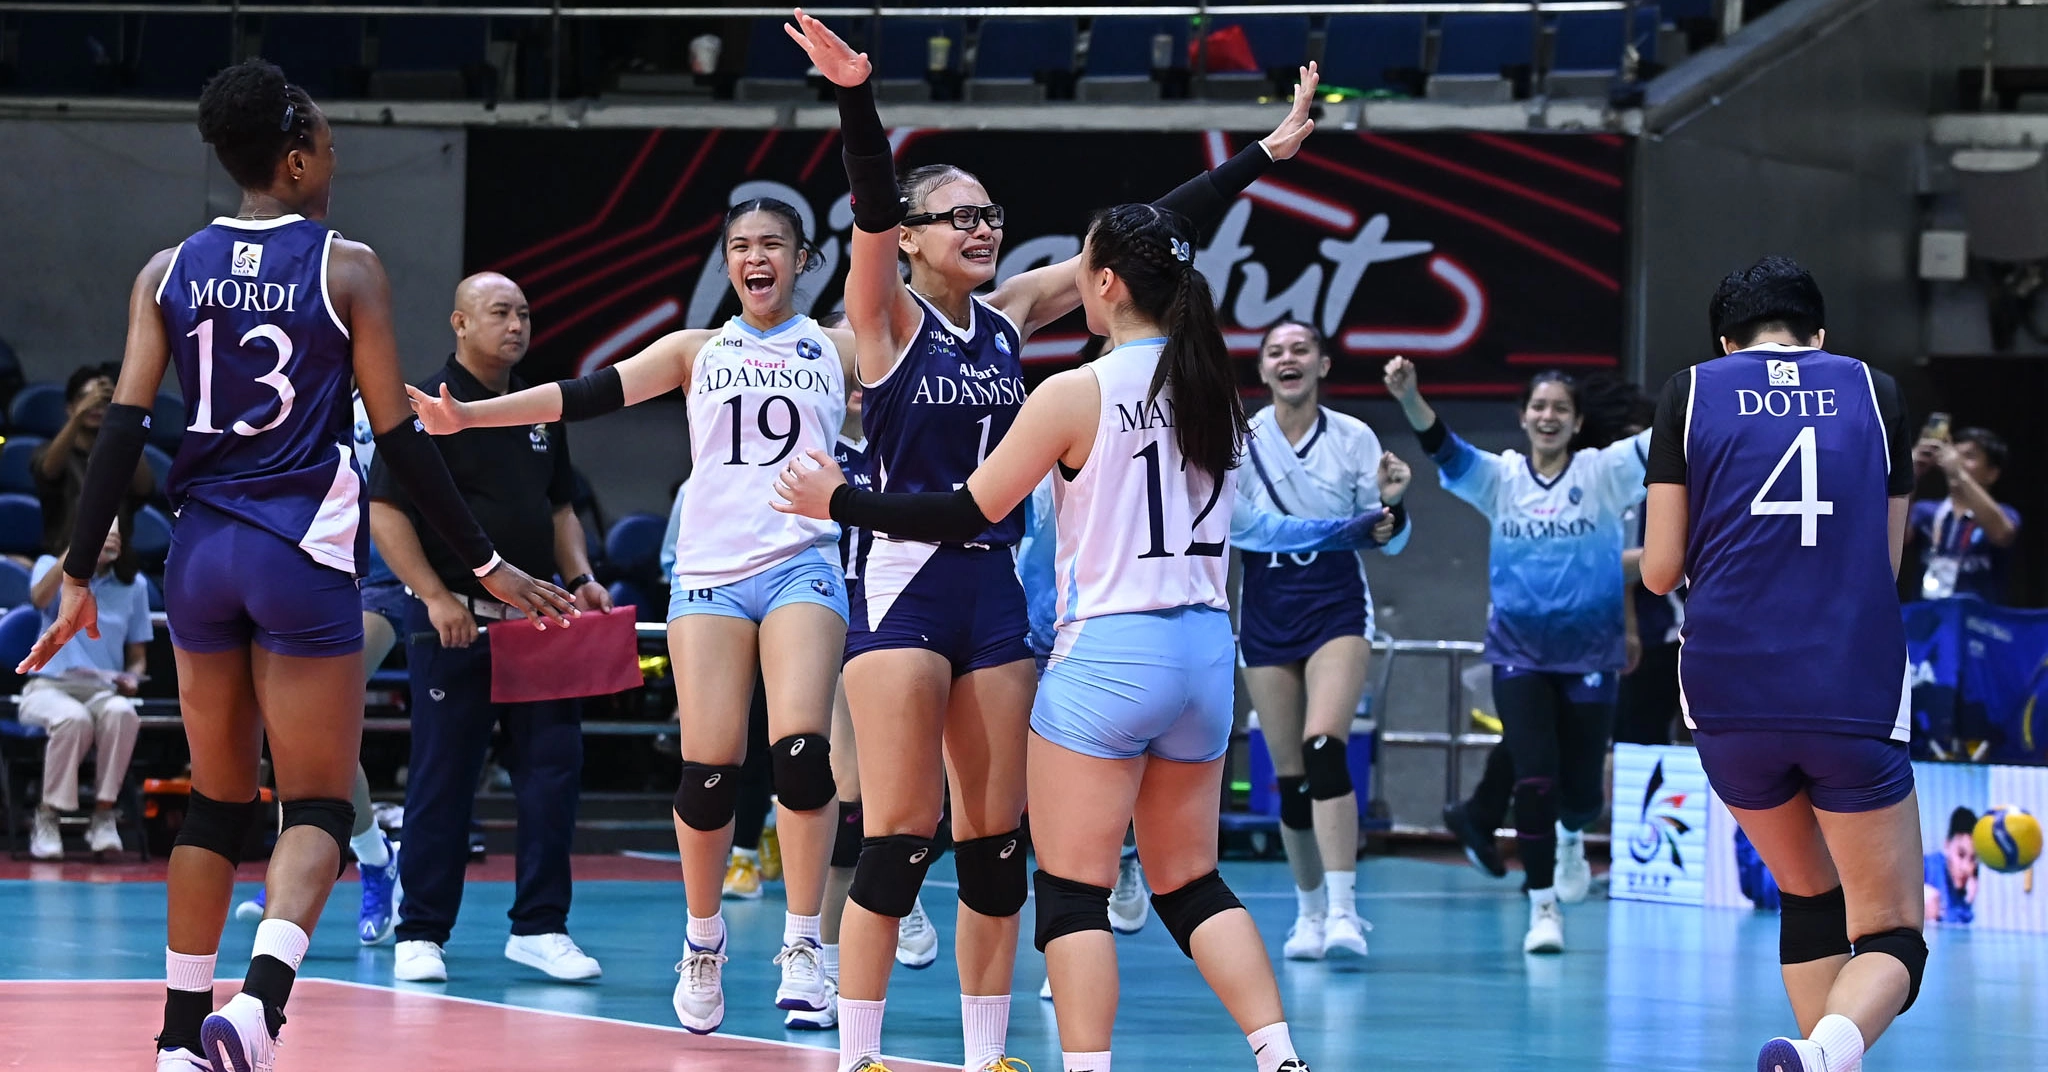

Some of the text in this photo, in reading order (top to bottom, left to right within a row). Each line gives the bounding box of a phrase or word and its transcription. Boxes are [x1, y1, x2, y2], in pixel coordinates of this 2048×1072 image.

[188, 278, 299, 312] MORDI
[186, 318, 296, 436] 13
[743, 358, 786, 369] Akari
[959, 363, 1001, 380] Akari
[699, 366, 831, 396] ADAMSON
[912, 374, 1025, 406] ADAMSO
[1735, 388, 1839, 417] DOTE
[722, 394, 801, 467] 19
[1132, 440, 1226, 559] 12
[1750, 426, 1834, 547] 4
